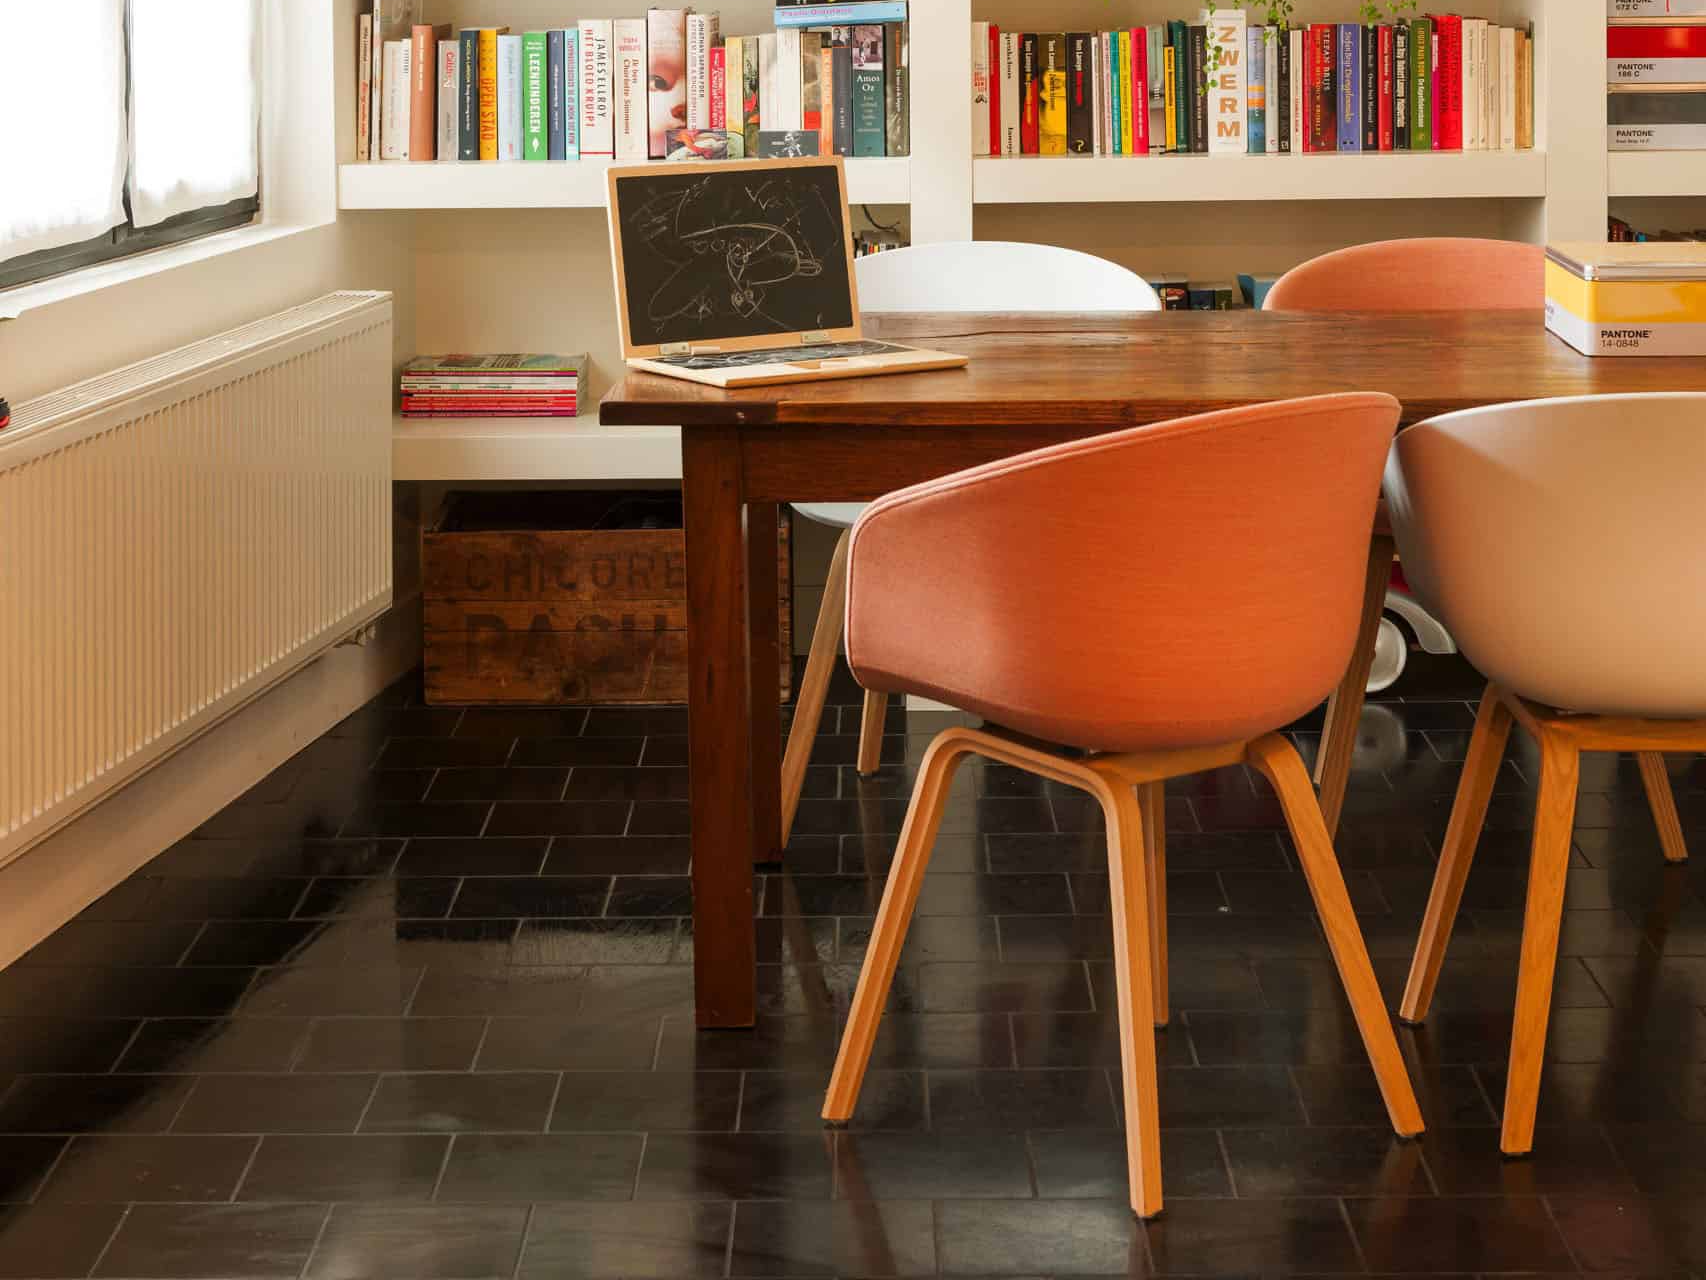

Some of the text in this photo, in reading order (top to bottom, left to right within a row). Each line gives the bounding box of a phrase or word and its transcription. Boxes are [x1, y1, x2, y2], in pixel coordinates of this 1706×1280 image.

[1072, 52, 1083, 71] Lanoye
[481, 78, 495, 107] OPEN
[584, 29, 595, 128] HET BLOED KRUIPT
[597, 38, 606, 118] JAMES ELLROY
[862, 83, 874, 92] Oz
[1217, 26, 1240, 137] ZWERM
[529, 53, 540, 134] LEENKINDEREN
[481, 112, 495, 140] STAD
[1601, 330, 1649, 338] PANTONE
